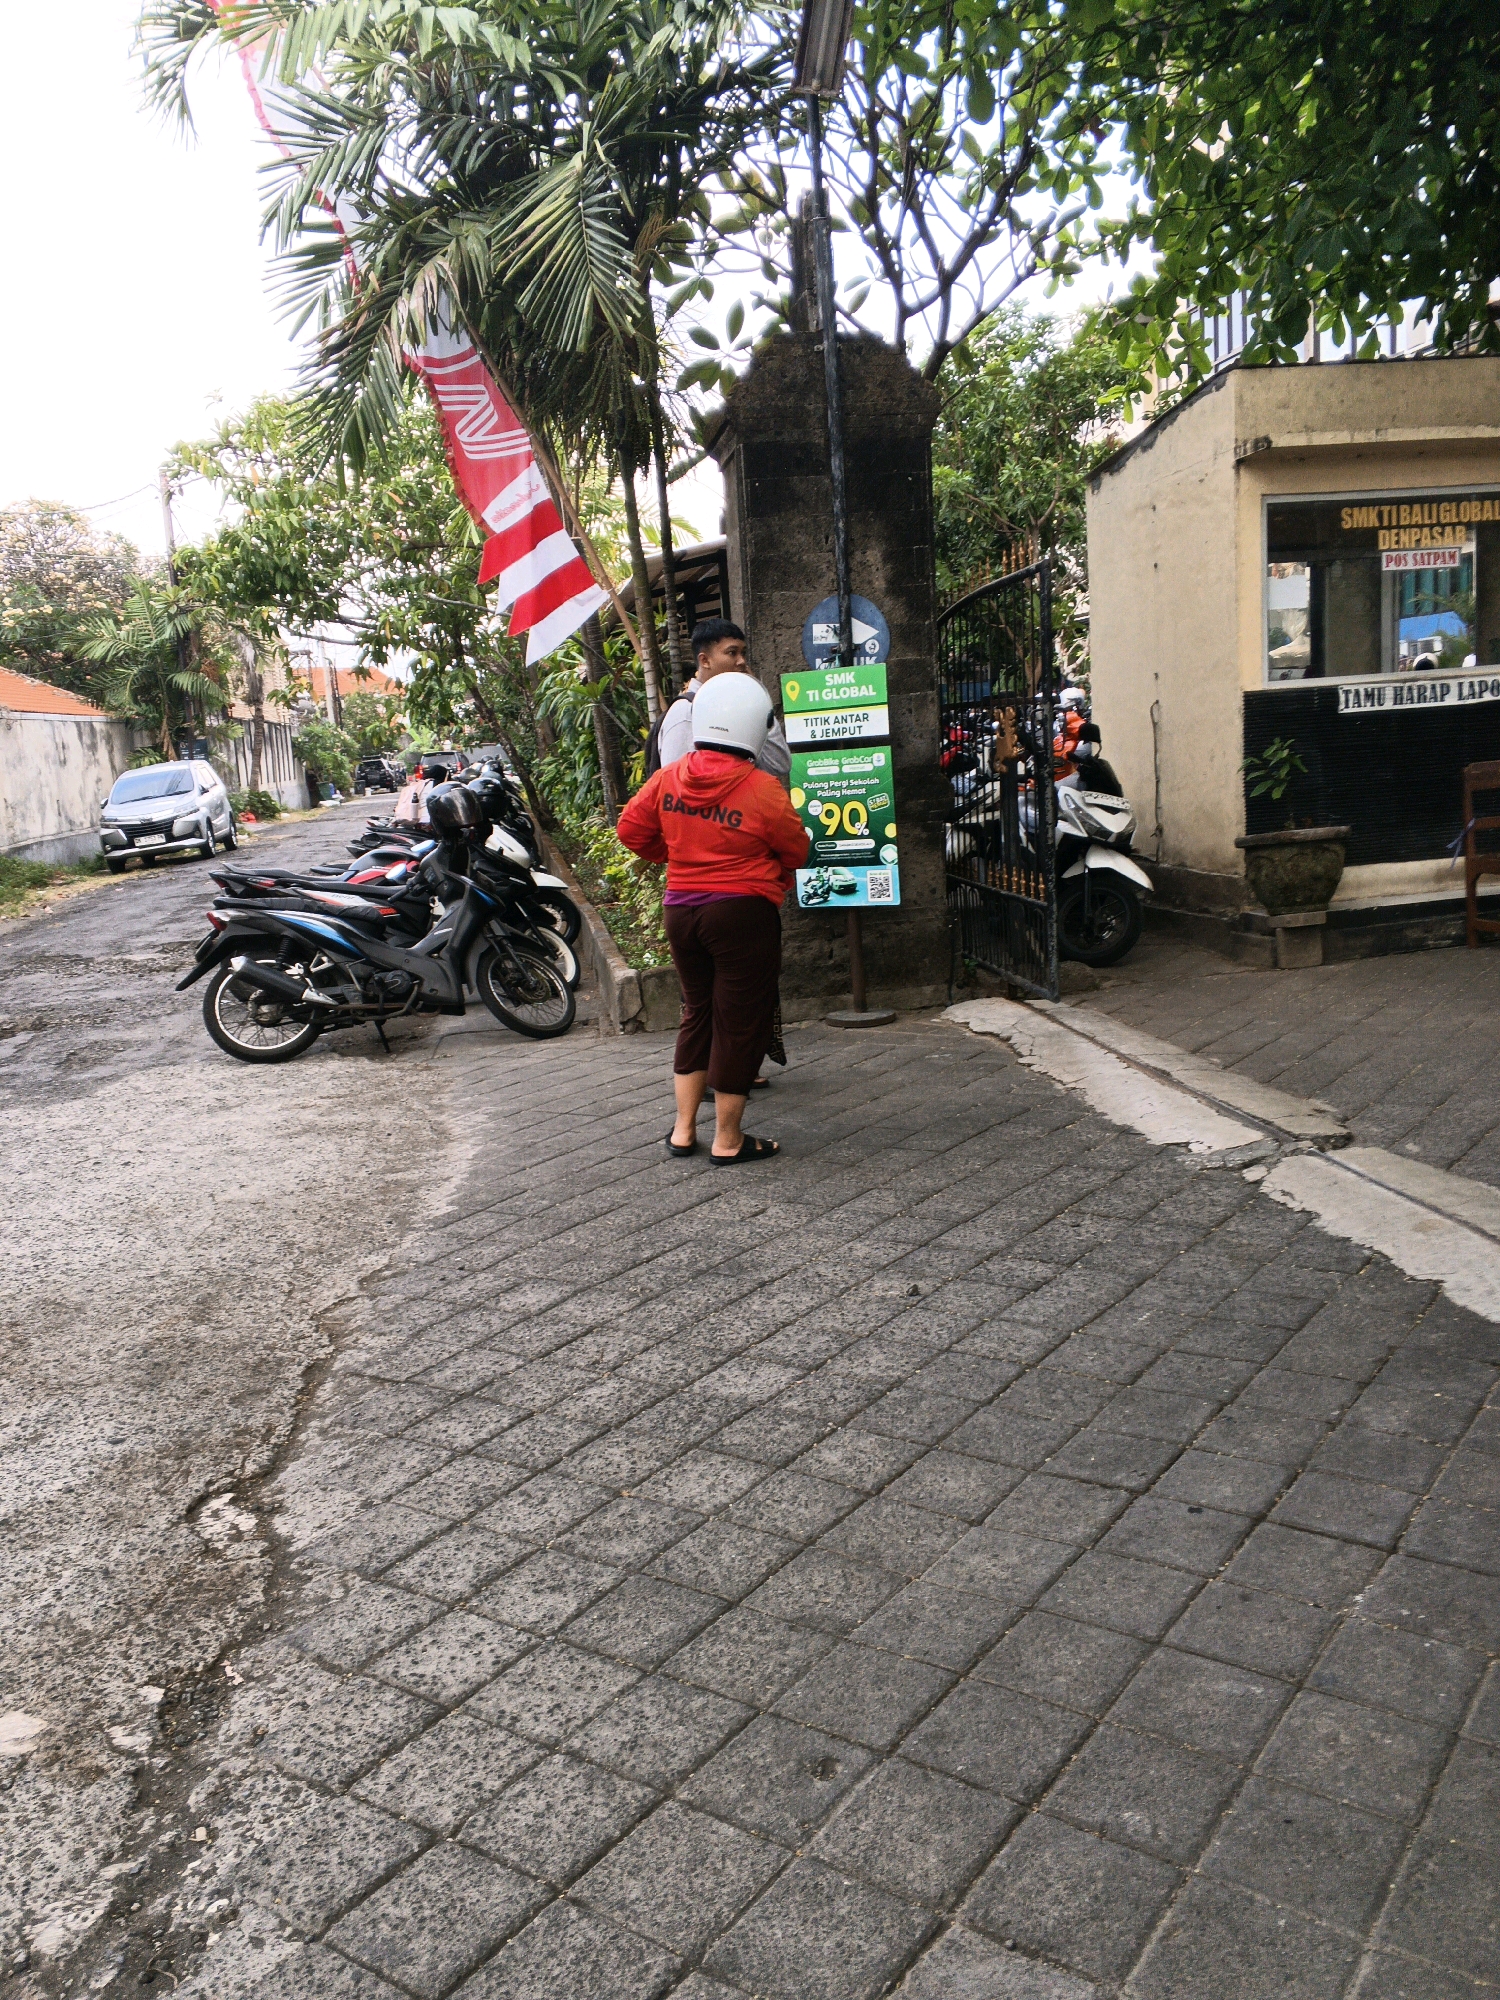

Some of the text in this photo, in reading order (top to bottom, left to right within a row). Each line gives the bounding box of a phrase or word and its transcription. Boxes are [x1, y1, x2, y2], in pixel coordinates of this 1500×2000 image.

[1341, 500, 1500, 529] SMK TI BALI GLOBAL
[1378, 526, 1466, 550] DENPASAR
[1385, 551, 1457, 568] POS SATPAM
[825, 671, 856, 686] SMK
[806, 684, 877, 702] TI GLOBAL
[1342, 687, 1386, 709] TAMU
[1393, 682, 1450, 706] HARAP
[804, 712, 870, 727] TITIK ANTAR
[810, 725, 863, 739] & JEMPUT
[807, 755, 874, 767] GrabBike GrabCar
[802, 777, 880, 789] Pulang Pergi Sekolah
[841, 787, 867, 796] Hemat
